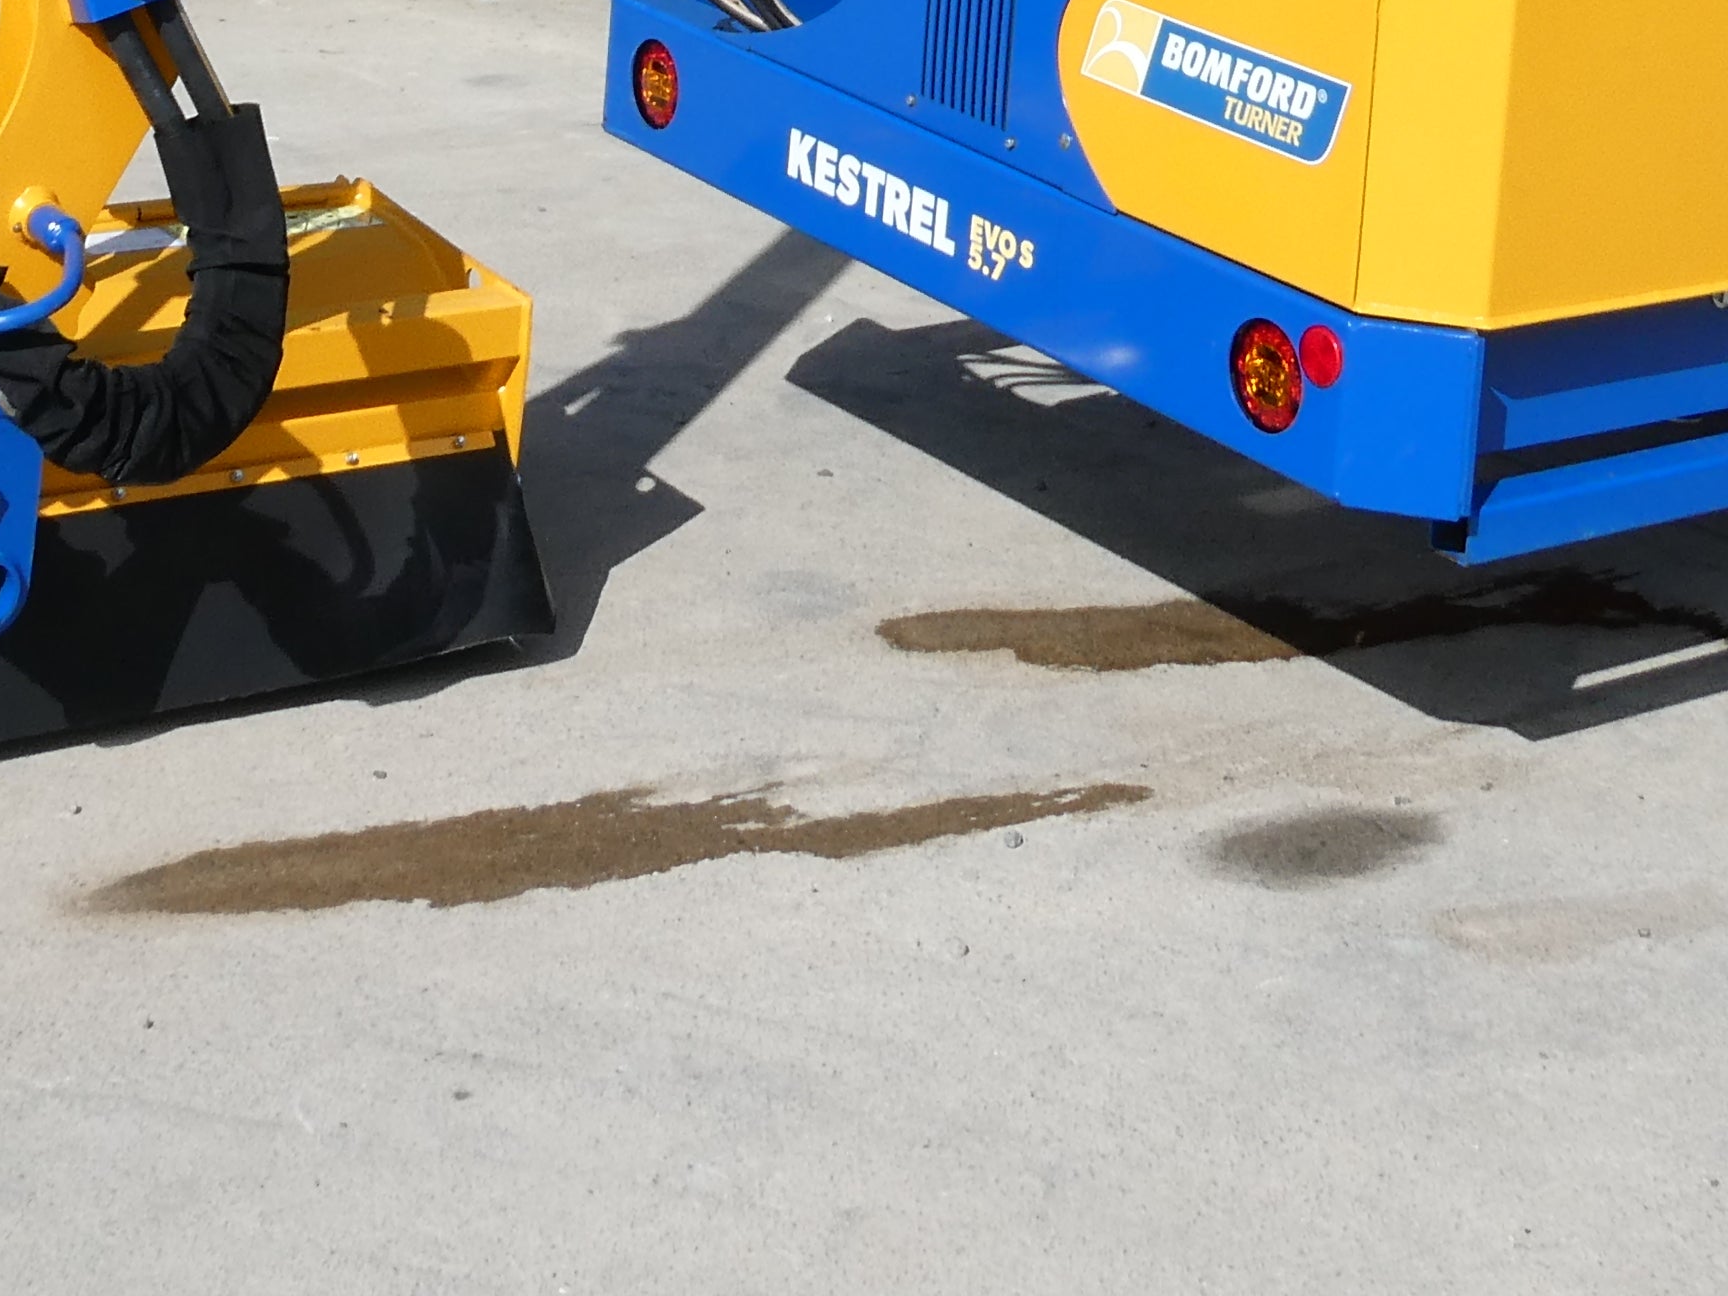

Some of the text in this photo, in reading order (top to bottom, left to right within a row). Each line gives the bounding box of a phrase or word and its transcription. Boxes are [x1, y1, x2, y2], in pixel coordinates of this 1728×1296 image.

[1161, 32, 1318, 120] BOMFORD
[1223, 95, 1303, 147] TURNER
[786, 127, 956, 257] KESTREL
[967, 240, 1007, 281] 5.7
[970, 213, 1017, 259] EVO
